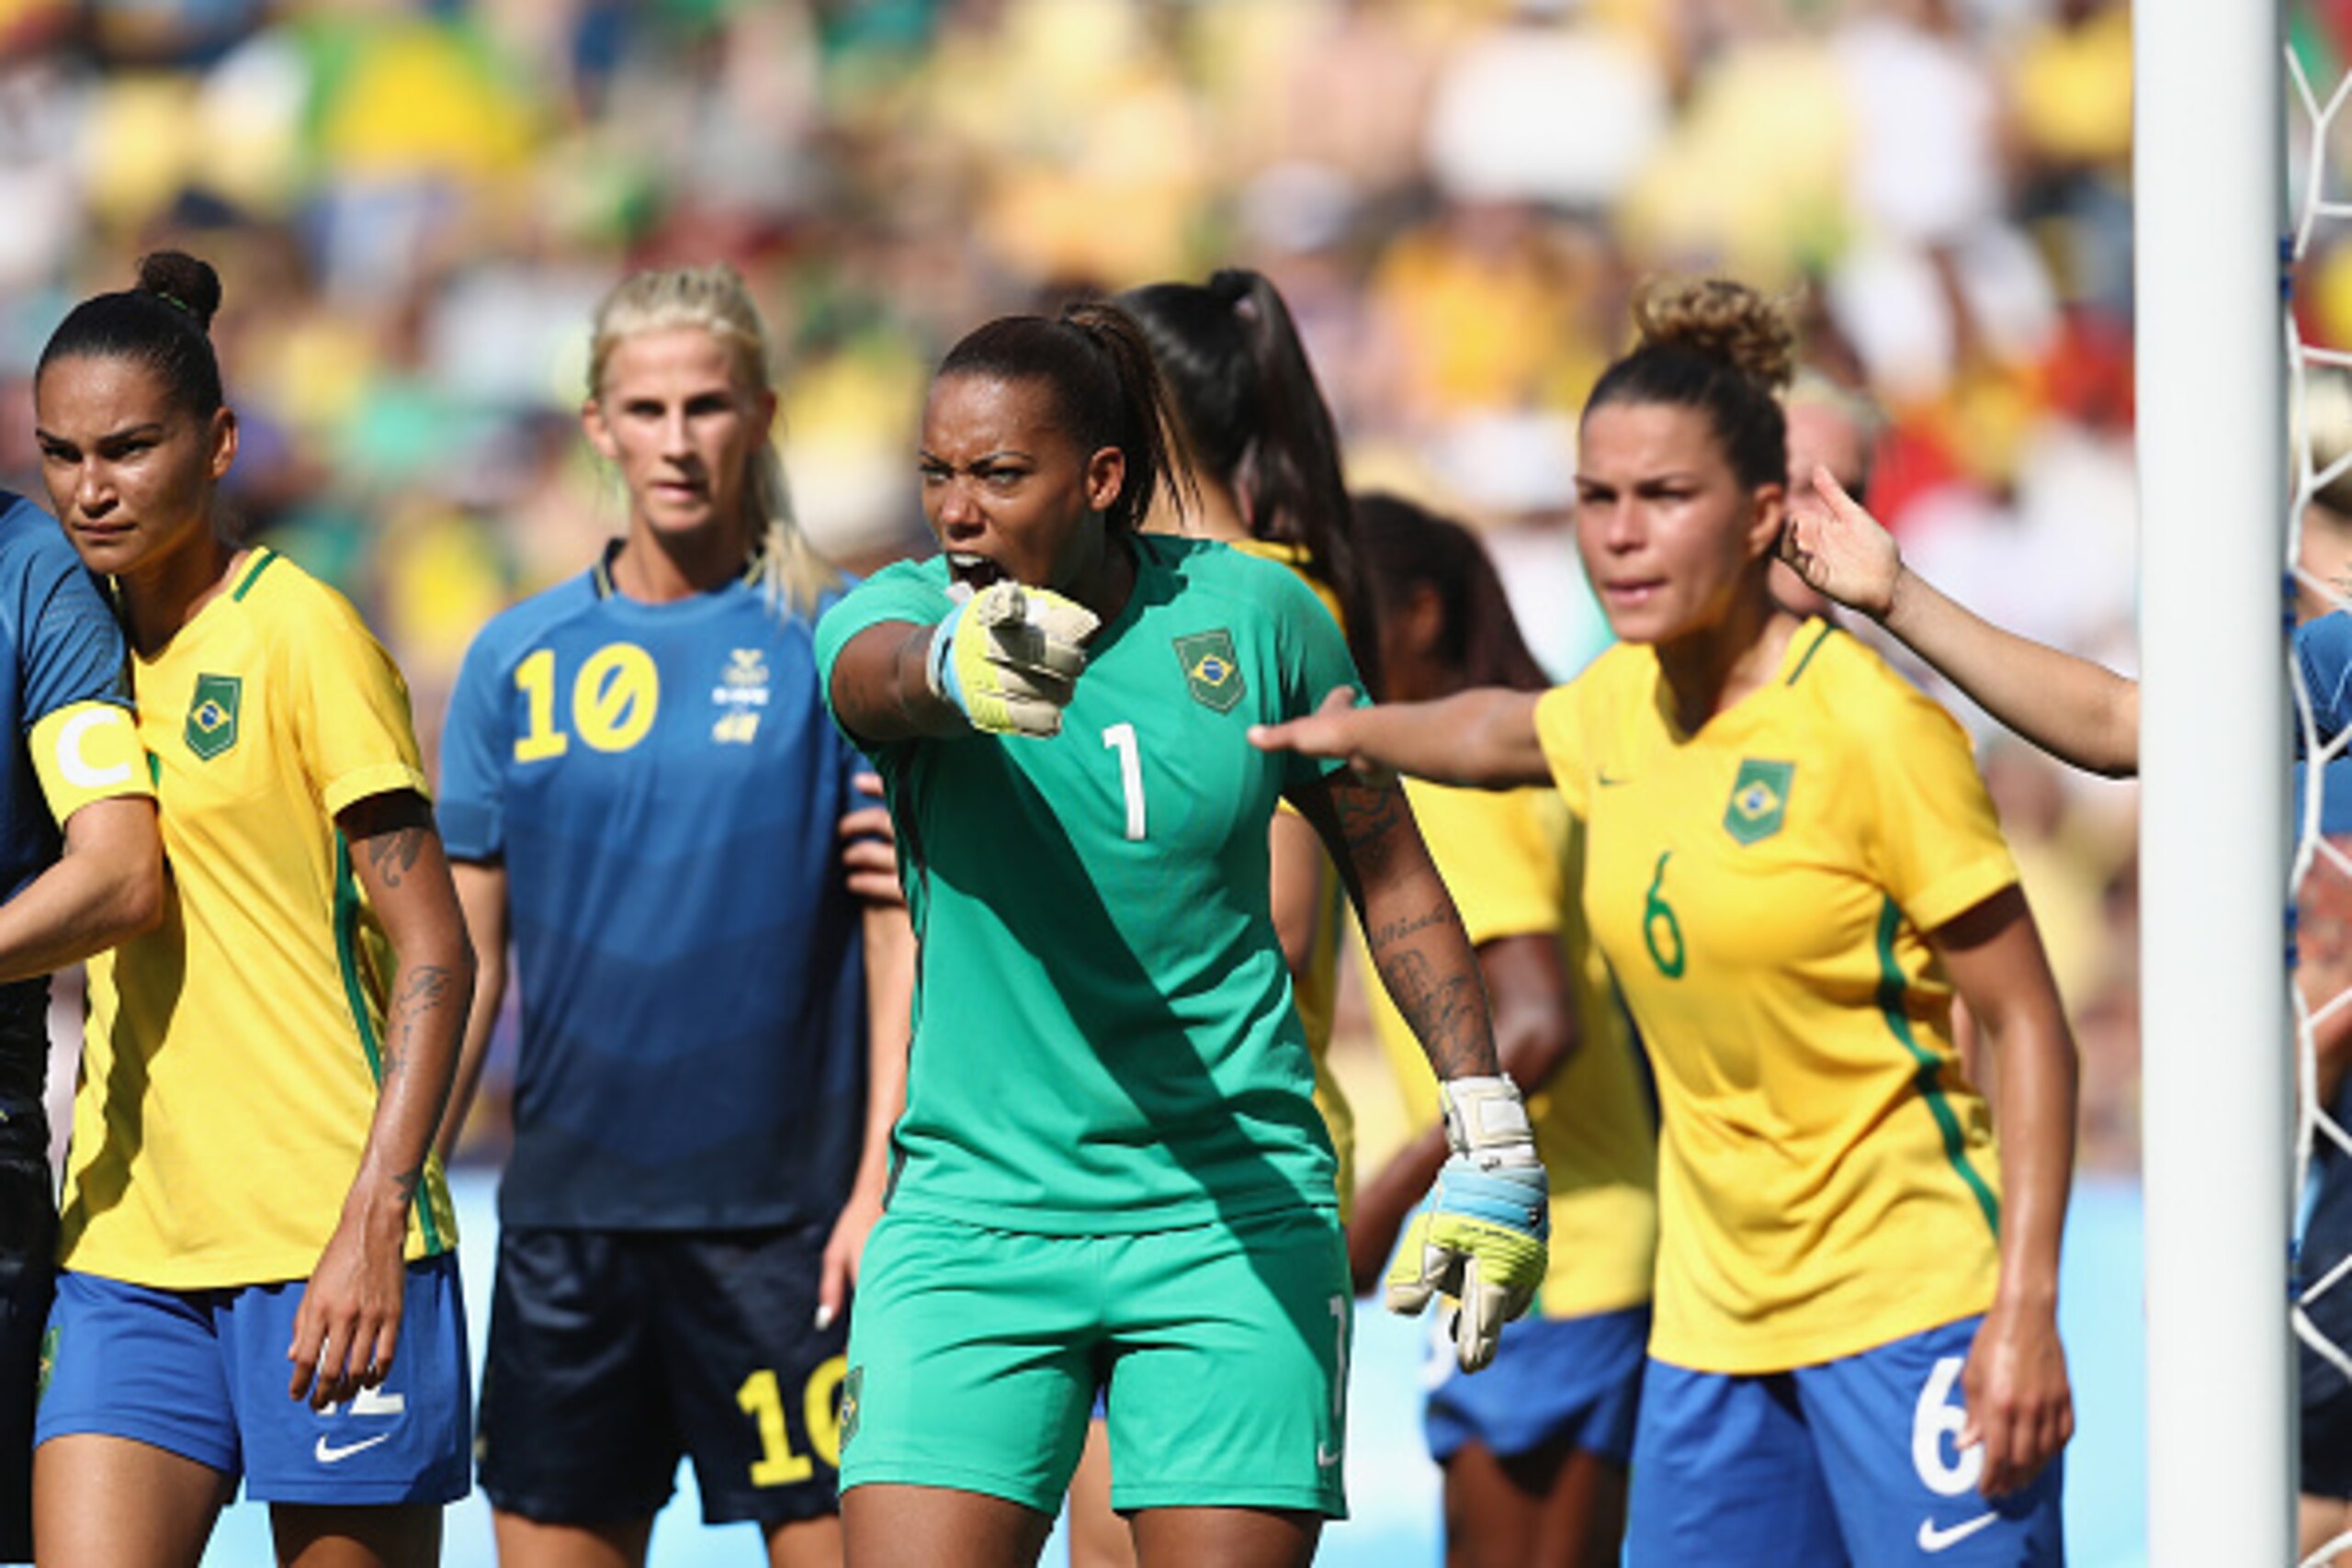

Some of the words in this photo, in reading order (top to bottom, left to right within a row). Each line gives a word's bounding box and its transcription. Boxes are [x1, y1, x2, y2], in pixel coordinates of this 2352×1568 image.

[56, 708, 131, 788] C
[514, 642, 659, 763] 10
[1102, 722, 1146, 840] 1
[1644, 851, 1685, 980] 6
[1912, 1357, 1985, 1497] 6
